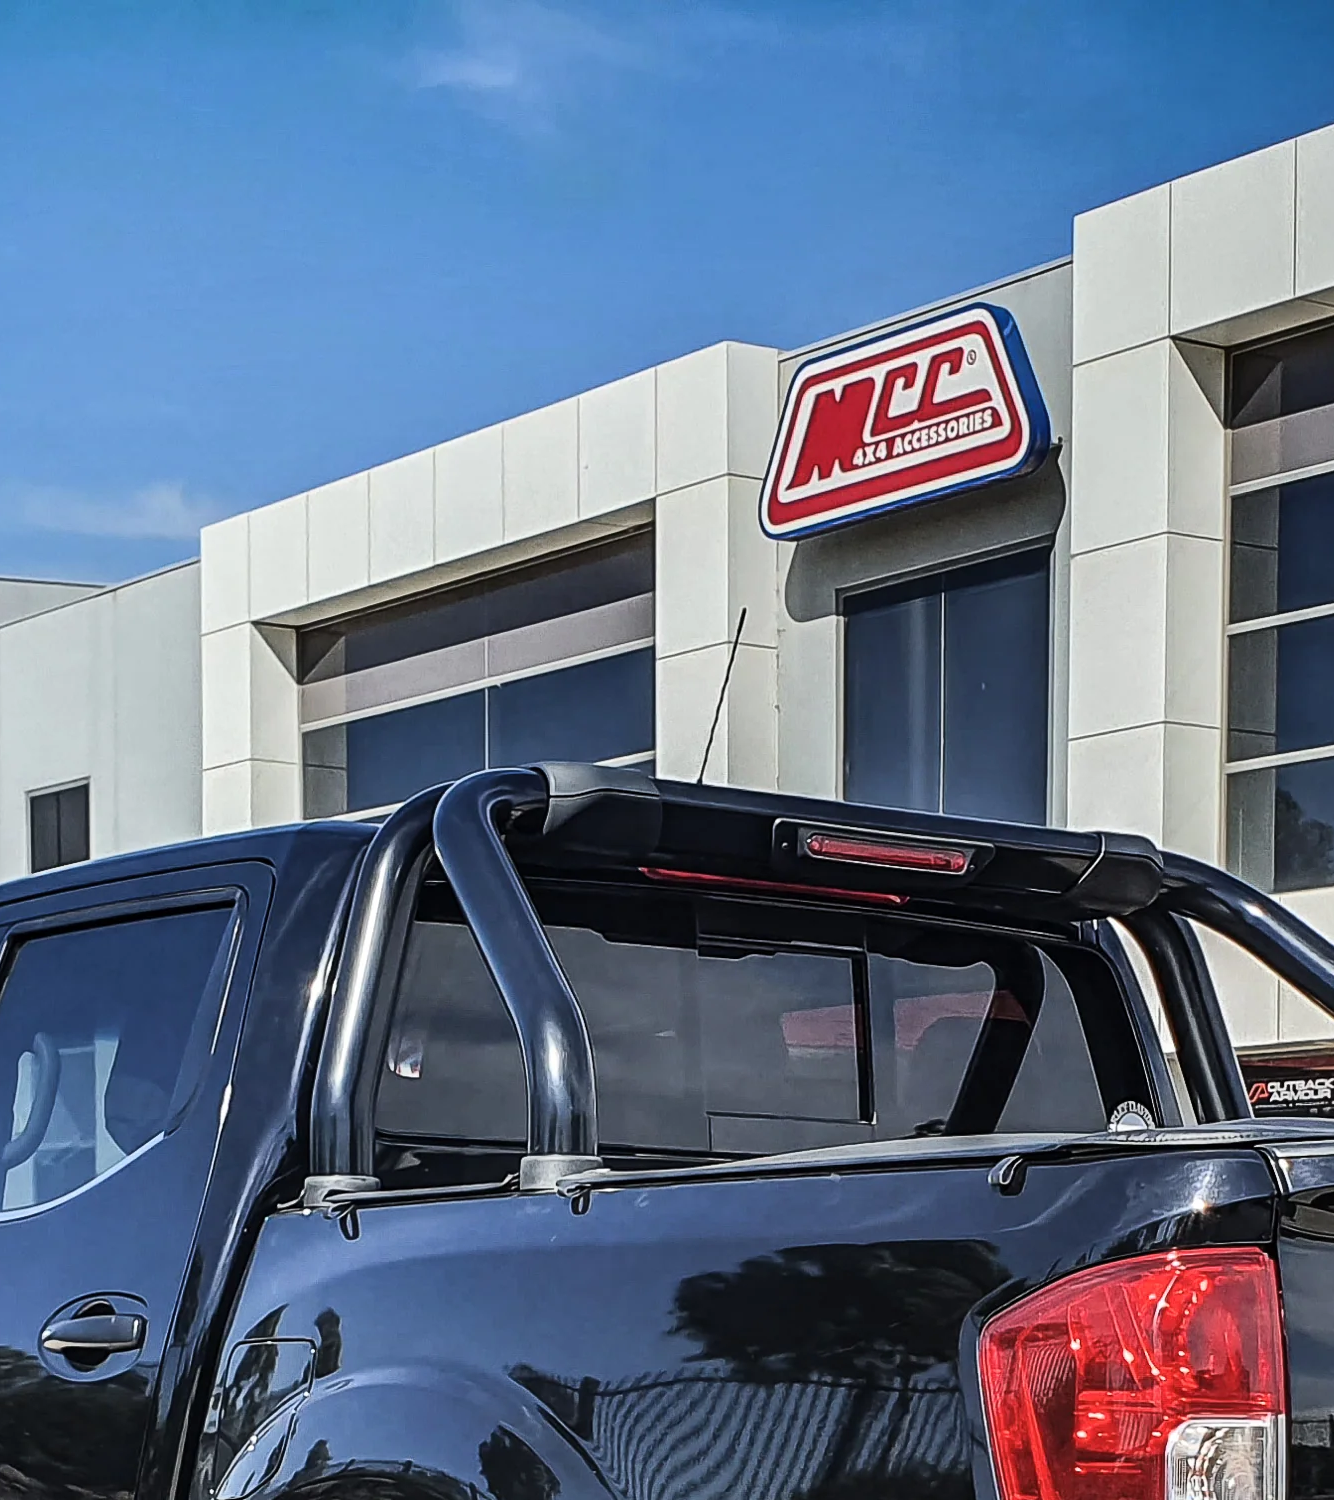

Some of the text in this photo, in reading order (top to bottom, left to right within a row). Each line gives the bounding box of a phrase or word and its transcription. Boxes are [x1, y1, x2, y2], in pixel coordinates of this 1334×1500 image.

[785, 347, 993, 491] MCC
[852, 409, 993, 466] 4X4 ACCESSORIES
[1267, 1078, 1334, 1092] OUTBACK
[1270, 1089, 1331, 1102] ARMOUR
